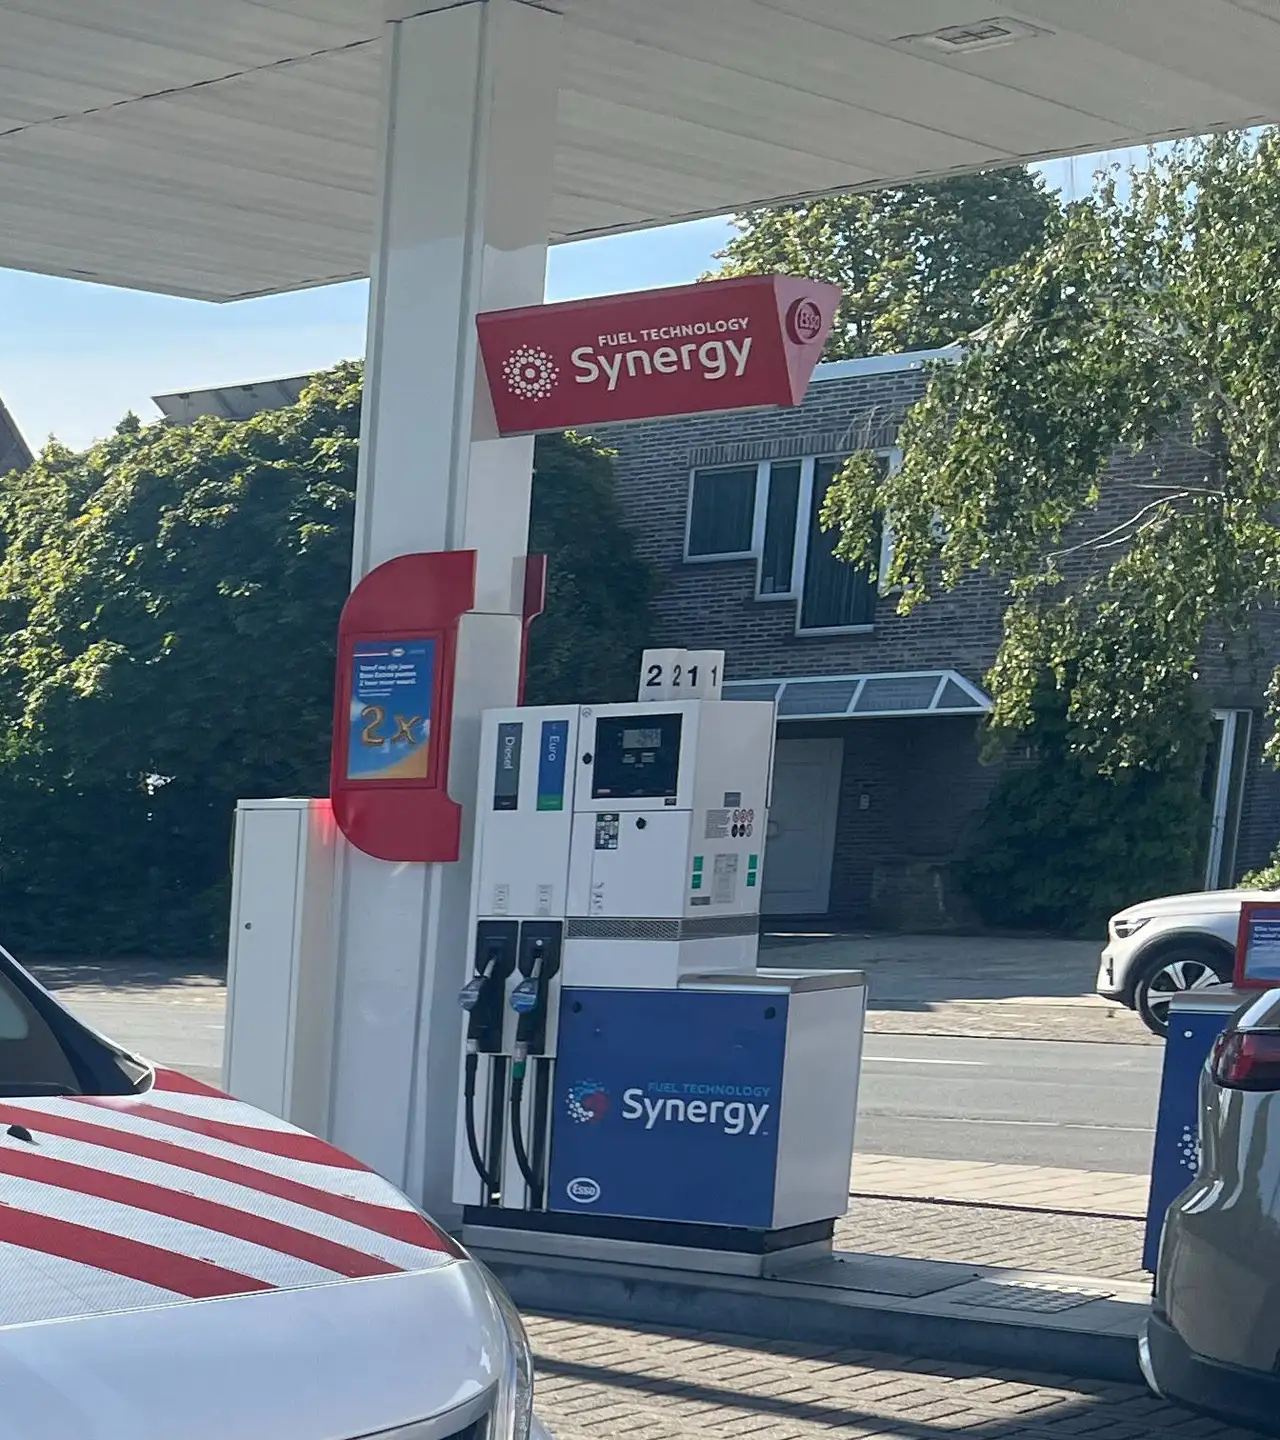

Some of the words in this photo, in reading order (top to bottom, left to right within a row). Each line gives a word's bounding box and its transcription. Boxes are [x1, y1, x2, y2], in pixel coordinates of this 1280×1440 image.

[598, 330, 637, 347] FUEL
[640, 317, 749, 342] TECHNOLOGY
[570, 337, 752, 391] Synergy
[646, 664, 662, 687] 2
[672, 664, 681, 687] 2
[687, 665, 698, 687] 1
[503, 736, 516, 770] Diesel
[548, 735, 560, 762] Euro
[647, 1082, 677, 1094] FUEL
[682, 1083, 771, 1098] TECHNOLOGY
[622, 1088, 770, 1135] Synergy
